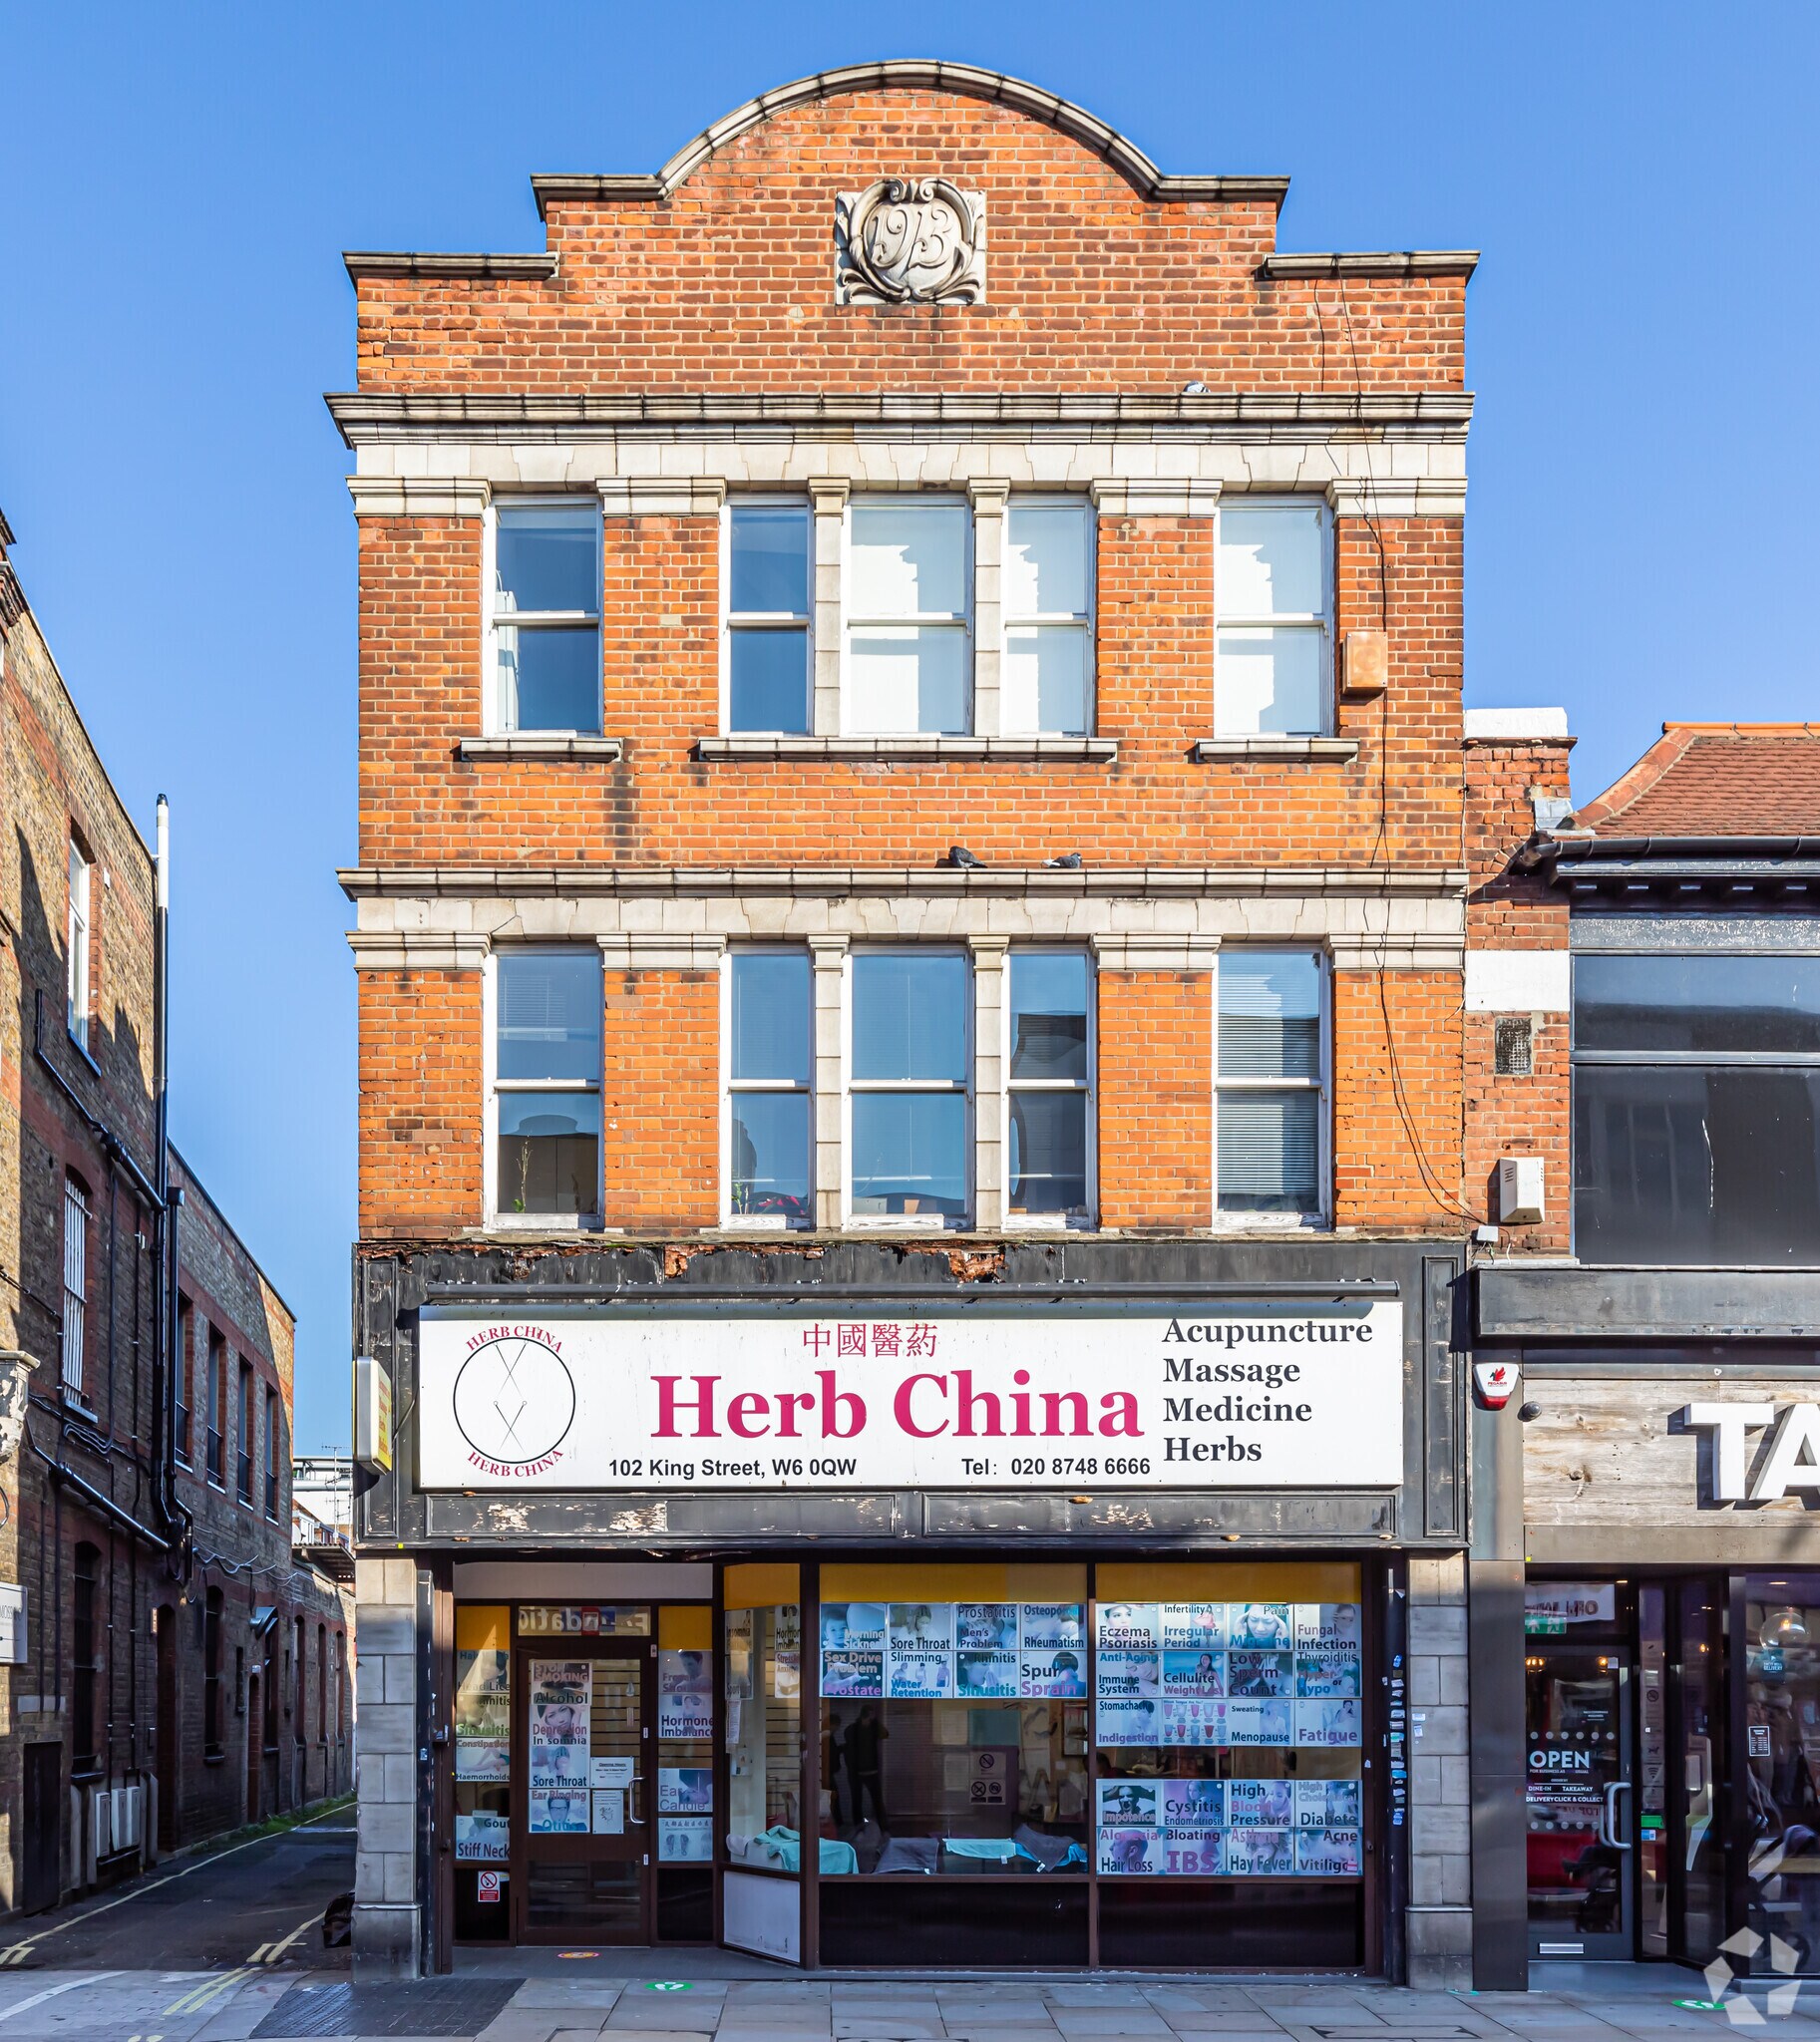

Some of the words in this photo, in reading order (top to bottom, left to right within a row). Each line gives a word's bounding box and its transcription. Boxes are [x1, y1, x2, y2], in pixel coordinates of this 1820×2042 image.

[466, 1326, 510, 1351] HERB
[514, 1325, 562, 1353] CHINA
[1162, 1318, 1373, 1348] Acupuncture
[1163, 1358, 1300, 1384] Massage
[650, 1370, 867, 1439] Herb
[895, 1369, 1145, 1438] China
[1163, 1395, 1312, 1422] Medicine
[1164, 1437, 1263, 1462] Herbs
[468, 1451, 510, 1476] HERB
[514, 1450, 563, 1477] CHINA
[609, 1459, 643, 1476] 102
[649, 1459, 695, 1480] King
[701, 1459, 766, 1479] Street,
[772, 1459, 803, 1476] W6
[809, 1459, 857, 1476] 0QW
[1011, 1458, 1045, 1475] 020
[1052, 1458, 1097, 1475] 8748
[1104, 1458, 1151, 1475] 6666
[957, 1604, 1016, 1618] Prostatitis
[1164, 1604, 1205, 1615] Infertility
[1264, 1605, 1289, 1615] Pain
[1099, 1625, 1151, 1637] Eczema
[1164, 1625, 1220, 1638] Irregular
[1297, 1623, 1336, 1638] Fungal
[891, 1636, 913, 1649] Sore
[915, 1636, 950, 1649] Throat
[960, 1639, 1003, 1648] Problem
[1024, 1636, 1084, 1648] Rheumatism
[1099, 1637, 1157, 1649] Psoriasis
[1164, 1638, 1201, 1648] Period
[1297, 1638, 1356, 1650] Infection
[824, 1651, 847, 1662] Sex
[849, 1651, 882, 1663] Drive
[891, 1652, 941, 1664] Slimming
[1099, 1652, 1158, 1664] Anti-Aging
[1230, 1652, 1262, 1664] Low
[1297, 1652, 1357, 1664] Thyroiditis
[534, 1672, 589, 1682] SMOKING
[1021, 1663, 1059, 1680] Spur
[1164, 1672, 1215, 1683] Cellulite
[1230, 1666, 1278, 1681] Sperm
[891, 1679, 922, 1689] Water
[1098, 1675, 1140, 1684] Immune
[489, 1681, 511, 1691] Lice
[958, 1682, 1017, 1697] Sinusitis
[1021, 1680, 1076, 1697] Sprain
[1098, 1684, 1140, 1696] System
[1164, 1685, 1200, 1696] Weight
[1202, 1685, 1225, 1696] Lss
[1230, 1683, 1277, 1696] Count
[536, 1692, 588, 1704] Alcohol
[891, 1688, 942, 1698] Retention
[1231, 1705, 1265, 1715] Sweating
[661, 1715, 713, 1727] Hormone
[1098, 1733, 1158, 1745] Indigestion
[1231, 1731, 1290, 1744] Menopause
[1298, 1728, 1357, 1745] Fatigue
[457, 1739, 511, 1748] Constipation
[1529, 1750, 1590, 1769] OPEN
[533, 1775, 554, 1787] Sore
[557, 1775, 587, 1787] Throat
[1297, 1781, 1323, 1793] High
[532, 1790, 547, 1801] Ear
[548, 1790, 587, 1803] Ringing
[659, 1785, 683, 1797] Ear
[1231, 1784, 1267, 1800] High
[659, 1799, 706, 1811] Candle
[1165, 1799, 1222, 1816] Cystitis
[1231, 1800, 1273, 1813] Blood
[1102, 1810, 1156, 1825] Impotence
[1164, 1815, 1225, 1826] Endometriosis
[1231, 1814, 1290, 1826] Pressure
[1100, 1829, 1159, 1841] Aloia
[1166, 1829, 1221, 1844] Bloating
[1322, 1829, 1358, 1842] Acne
[458, 1843, 481, 1858] Stiff
[483, 1843, 511, 1859] Neck
[1101, 1857, 1126, 1872] Hair
[1128, 1857, 1153, 1872] Loss
[1166, 1851, 1216, 1873] IBS
[1230, 1855, 1254, 1873] Hay
[1257, 1855, 1291, 1872] Fever
